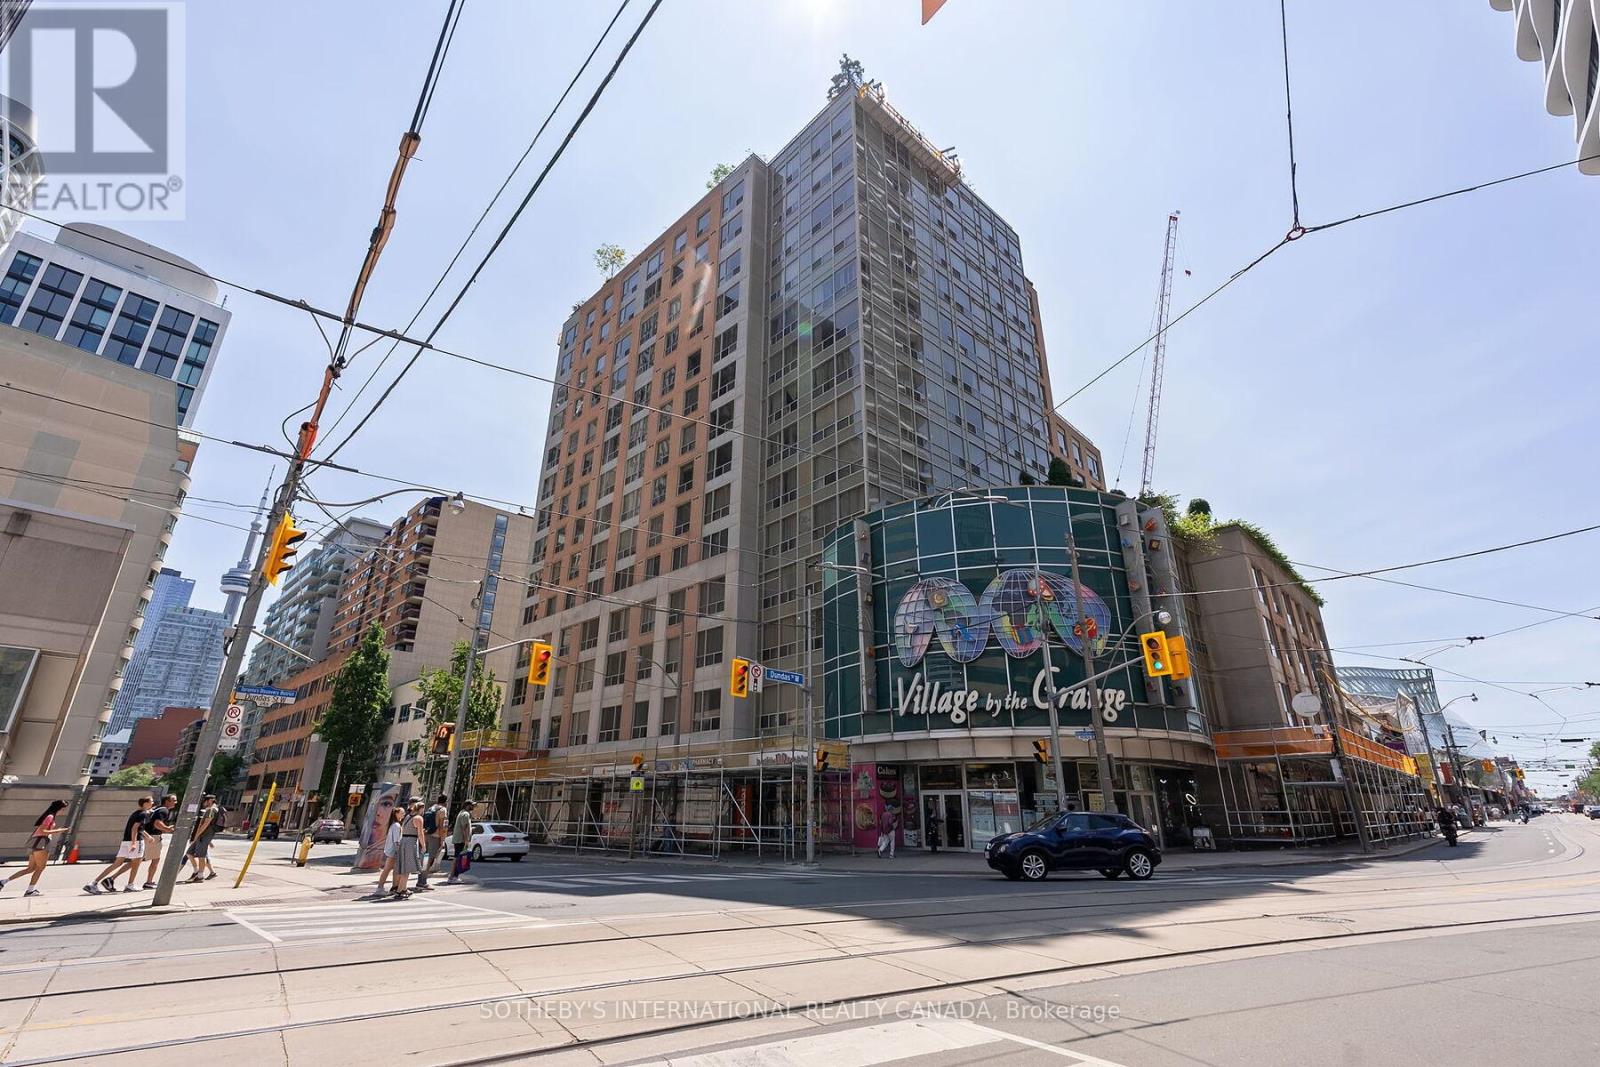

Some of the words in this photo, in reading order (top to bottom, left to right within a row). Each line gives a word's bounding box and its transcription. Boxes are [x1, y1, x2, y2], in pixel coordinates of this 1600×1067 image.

[769, 670, 790, 681] Dundas
[245, 693, 271, 702] Dundas
[897, 672, 978, 724] Village
[985, 690, 1002, 717] by
[1005, 690, 1028, 710] the
